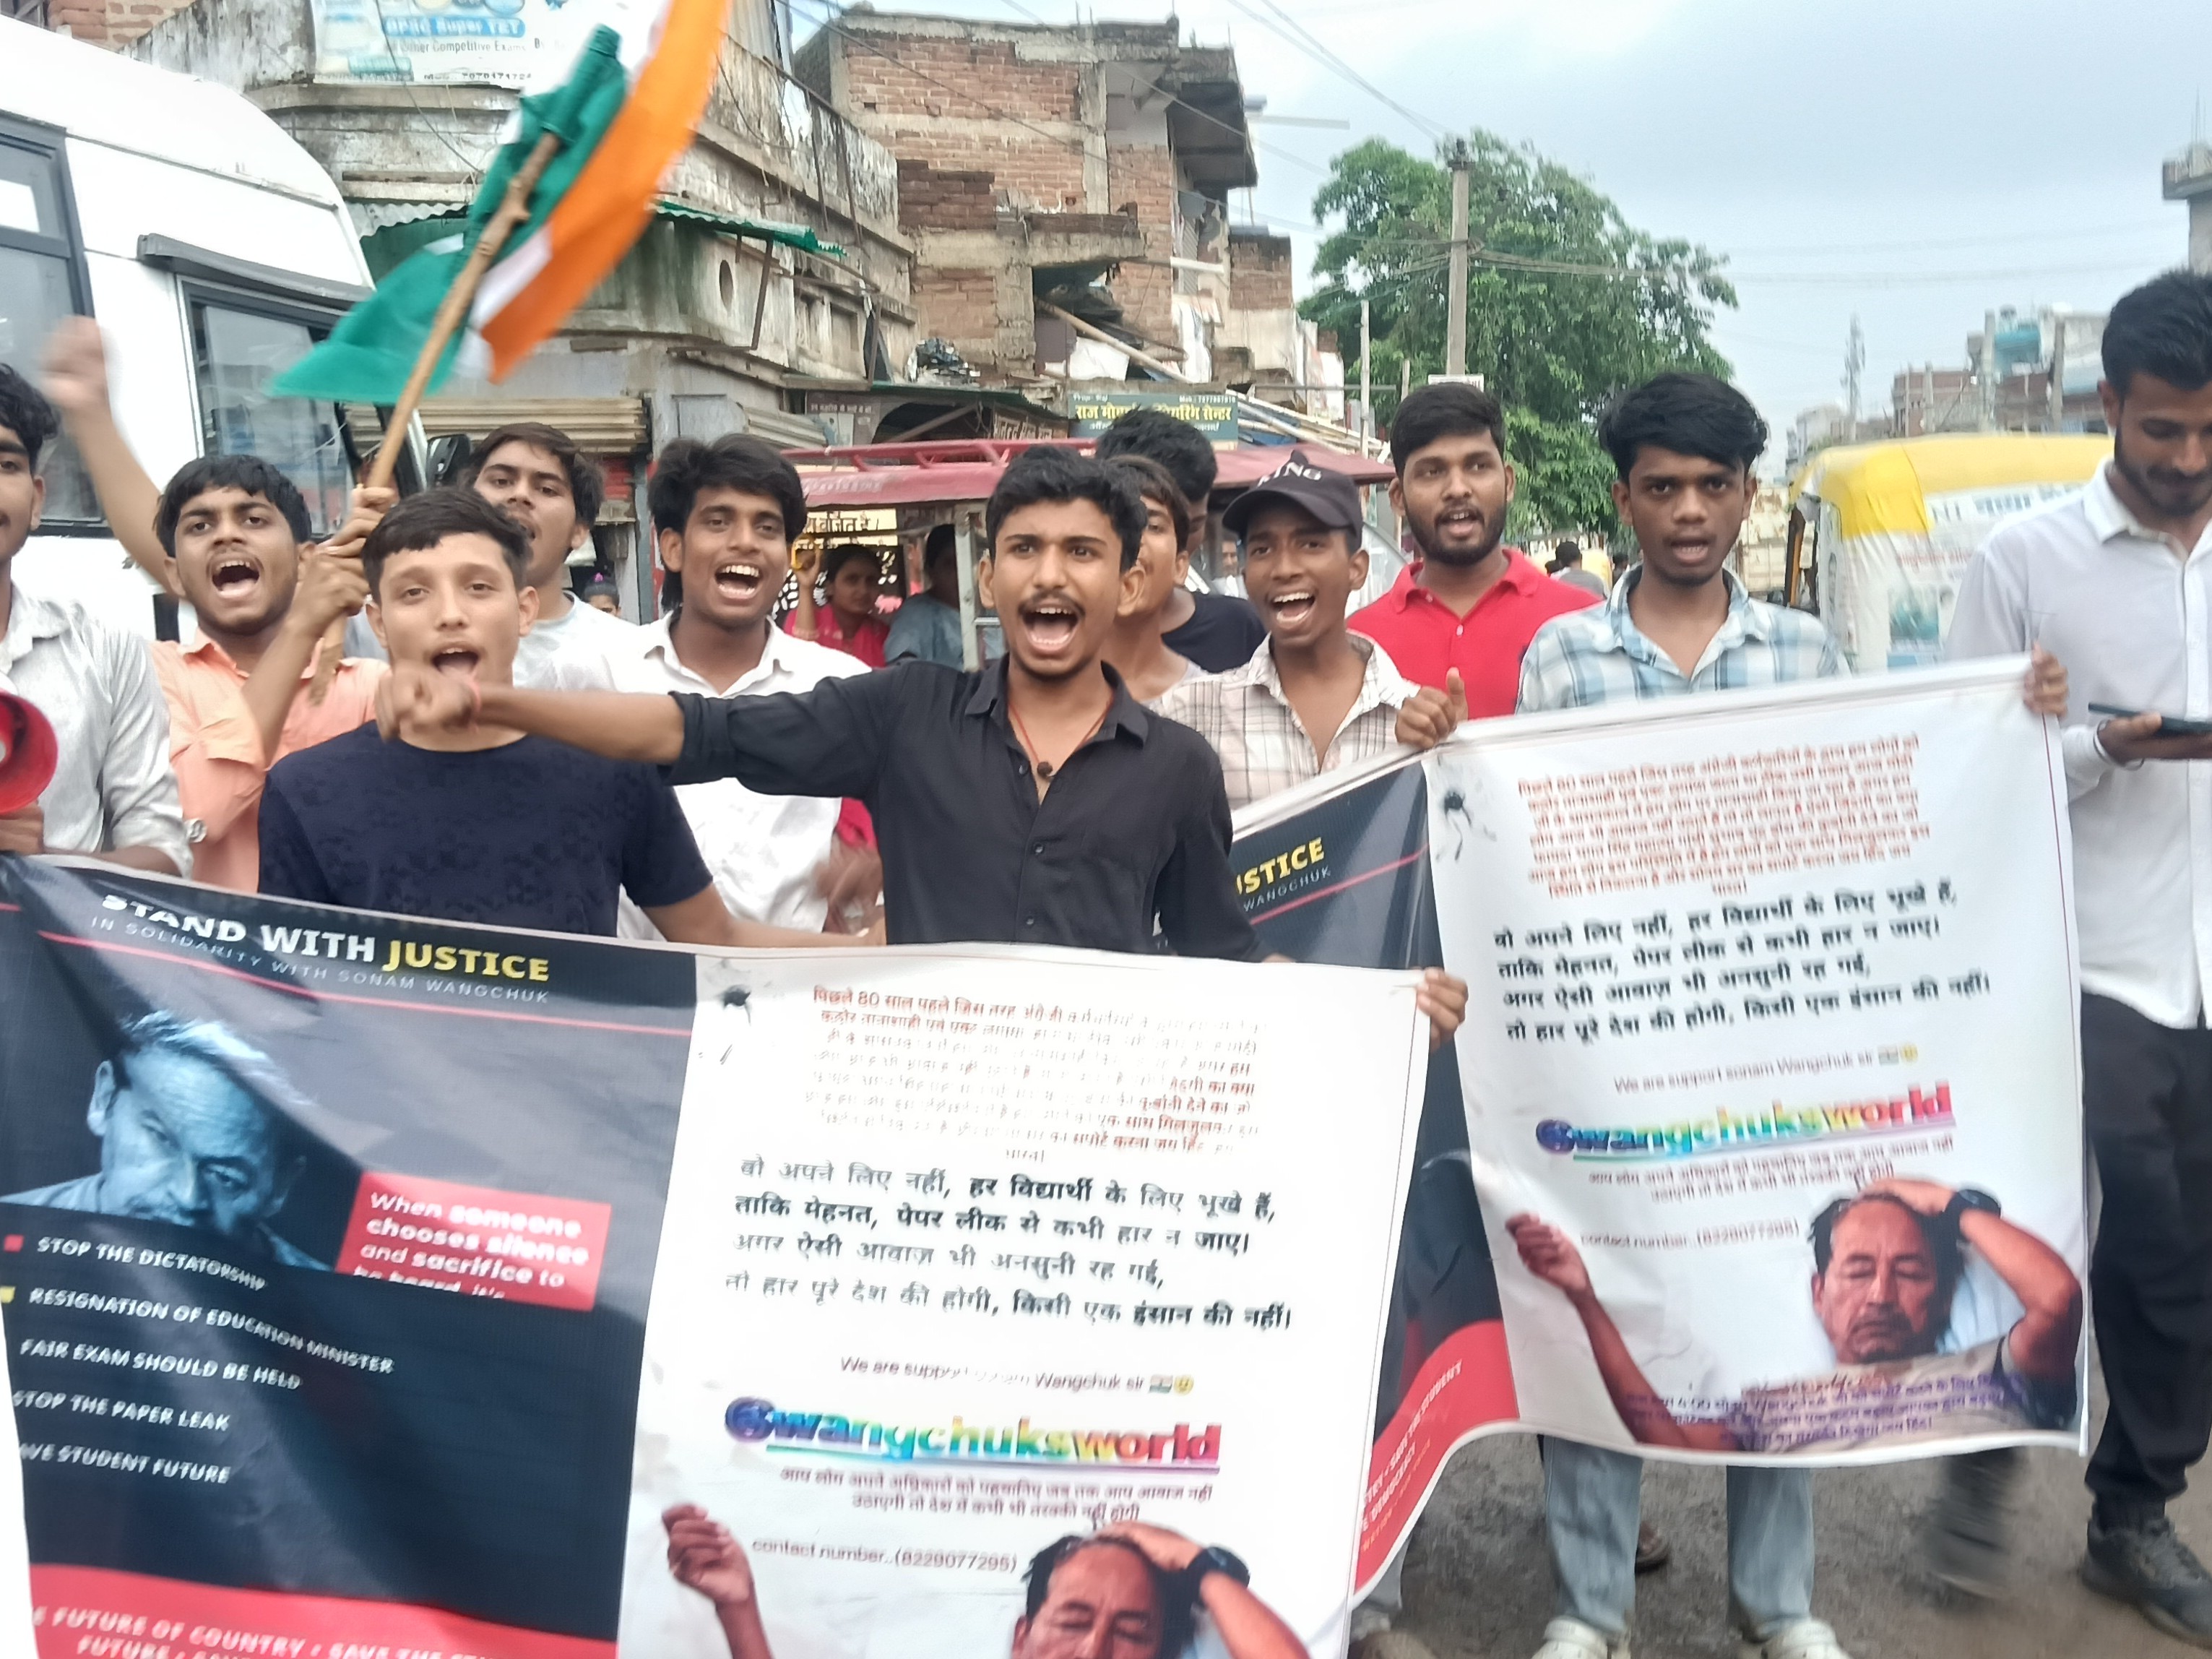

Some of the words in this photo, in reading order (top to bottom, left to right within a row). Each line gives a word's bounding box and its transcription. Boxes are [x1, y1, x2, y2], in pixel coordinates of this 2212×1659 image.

[433, 41, 491, 53] Competitive
[1235, 836, 1326, 895] STICE
[1243, 864, 1332, 913] WANGCHUK
[102, 894, 247, 942] STAND
[260, 924, 376, 962] WITH
[381, 939, 550, 982] JUSTICE
[1493, 925, 1514, 949] वो
[1524, 921, 1574, 949] अपने
[1583, 918, 1623, 946] लिए
[1686, 909, 1713, 933] हर
[1721, 900, 1794, 928] विद्यार्थी
[1802, 890, 1825, 916] के
[1833, 887, 1876, 915] लिए
[1885, 879, 1927, 915] भूखे
[91, 916, 114, 931] IN
[125, 922, 262, 967] SOLIDARITY
[271, 960, 328, 980] WITH
[337, 969, 415, 990] SONAM
[425, 979, 550, 1004] WANGCHUK
[1497, 955, 1544, 981] ताकि
[1554, 952, 1619, 981] मेहनत,
[1632, 943, 1672, 970] पेपर
[1680, 935, 1727, 961] लीक
[1734, 929, 1755, 957] से
[1763, 922, 1810, 954] कभी
[1818, 923, 1853, 952] हार
[1861, 920, 1879, 944] न
[857, 991, 881, 1008] 80
[1503, 988, 1545, 1010] अगर
[1554, 980, 1594, 1012] ऐसी
[1681, 967, 1707, 994] भी
[1716, 956, 1792, 992] अनसुनी
[1800, 955, 1826, 983] रह
[1505, 1016, 1527, 1043] तो
[1533, 1020, 1566, 1043] हार
[1573, 1013, 1600, 1048] पूरे
[1608, 1011, 1641, 1039] देश
[1648, 1004, 1677, 1032] की
[1742, 989, 1796, 1022] किसी
[1803, 989, 1841, 1017] एक
[1911, 974, 1940, 1003] की
[1613, 1074, 1640, 1095] We
[1643, 1073, 1665, 1093] are
[1668, 1064, 1723, 1090] support
[1776, 1051, 1854, 1078] Wangchuk
[1536, 1080, 1953, 1156] @wangchuksworld
[778, 1159, 835, 1183] अपने
[847, 1161, 894, 1192] लिए
[905, 1168, 951, 1199] नहीं,
[969, 1177, 999, 1199] हर
[1010, 1173, 1094, 1203] विद्यार्थी
[1105, 1178, 1128, 1205] के
[1140, 1183, 1185, 1213] लिए
[1198, 1189, 1243, 1218] भूखे
[366, 1215, 480, 1251] chooses
[485, 1233, 589, 1267] silence
[370, 1192, 444, 1219] When
[448, 1204, 582, 1240] someone
[734, 1191, 793, 1218] ताकि
[803, 1195, 878, 1231] मेहनत,
[896, 1202, 945, 1229] पेपर
[954, 1205, 1008, 1232] लीक
[1019, 1209, 1041, 1234] से
[1053, 1215, 1105, 1240] कभी
[1117, 1225, 1154, 1245] हार
[1165, 1229, 1182, 1248] न
[37, 1236, 92, 1257] STOP
[96, 1243, 136, 1264] THE
[138, 1248, 268, 1292] DICTATORSHIP
[360, 1244, 410, 1264] and
[411, 1251, 534, 1285] sacrifice
[539, 1269, 566, 1288] to
[733, 1233, 785, 1252] अगर
[796, 1231, 844, 1260] ऐसी
[949, 1243, 977, 1270] भी
[990, 1250, 1076, 1281] अनसुनी
[1089, 1259, 1116, 1283] रह
[725, 1269, 751, 1292] तो
[762, 1275, 799, 1299] हार
[811, 1276, 840, 1307] पूरे
[851, 1277, 888, 1304] देश
[899, 1280, 930, 1306] की
[941, 1284, 1000, 1318] होगी,
[1012, 1288, 1072, 1316] किसी
[1084, 1301, 1122, 1326] एक
[1202, 1299, 1235, 1328] की
[28, 1287, 170, 1320] RESIGNATION
[173, 1305, 203, 1323] OF
[206, 1308, 304, 1351] EDUCATION
[306, 1340, 396, 1374] MINISTER
[20, 1338, 70, 1358] FAIR
[72, 1343, 131, 1366] EXAM
[131, 1352, 218, 1378] SHOULD
[222, 1362, 250, 1382] BE
[252, 1366, 302, 1390] HELD
[840, 1356, 869, 1374] We
[873, 1360, 900, 1376] are
[1034, 1371, 1121, 1395] Wangchuk
[1126, 1374, 1146, 1392] sir
[12, 1389, 67, 1410] STOP
[71, 1394, 110, 1416] THE
[111, 1400, 174, 1426] PAPER
[178, 1410, 232, 1432] LEAK
[724, 1396, 1222, 1465] @wangchuksworld
[57, 1444, 151, 1473] STUDENT
[152, 1458, 232, 1485] FUTURE
[752, 1539, 816, 1559] contact
[52, 1606, 148, 1637] FUTURE
[150, 1619, 186, 1642] OF
[189, 1625, 307, 1658] COUNTRY
